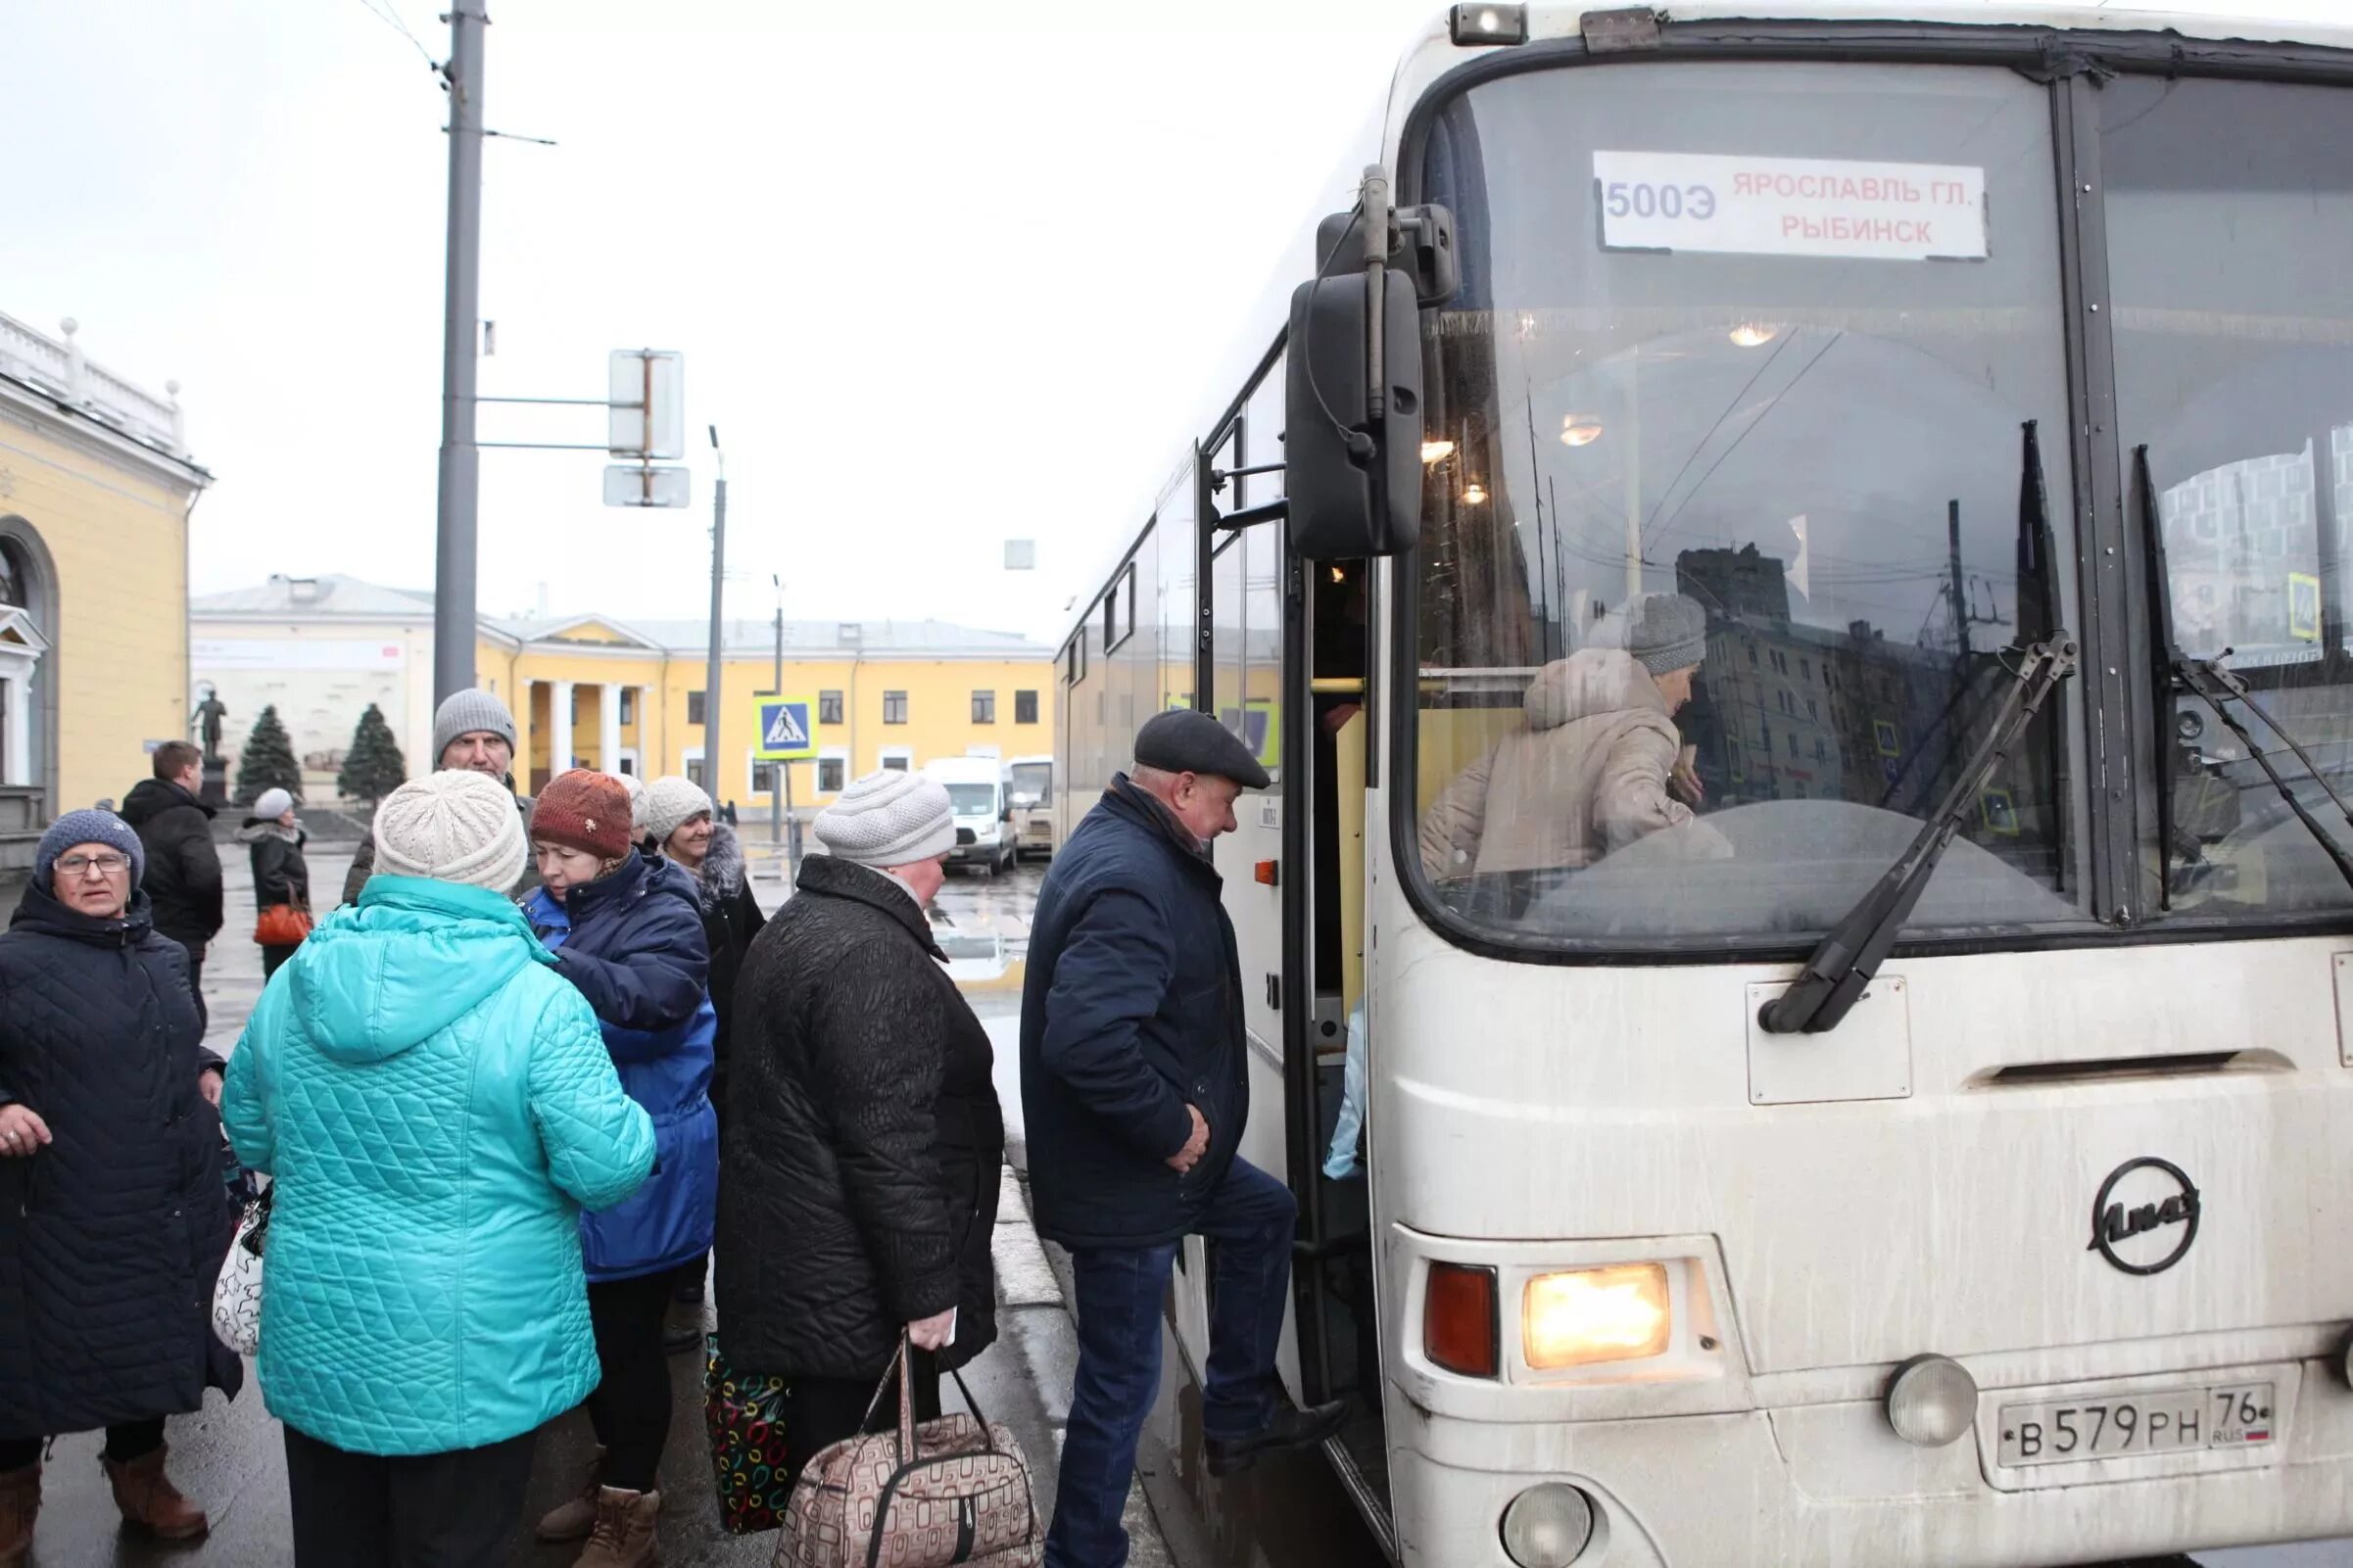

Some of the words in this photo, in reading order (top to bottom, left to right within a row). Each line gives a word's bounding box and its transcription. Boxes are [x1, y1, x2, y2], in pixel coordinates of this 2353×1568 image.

[1607, 181, 1716, 221] 500Э
[1733, 172, 1921, 205] ЯРОСЛАВЛЬ
[1931, 181, 1974, 207] ГЛ.
[1781, 214, 1934, 244] РЫБИНСК
[2216, 1392, 2258, 1425] 76
[2212, 1428, 2243, 1443] RUS
